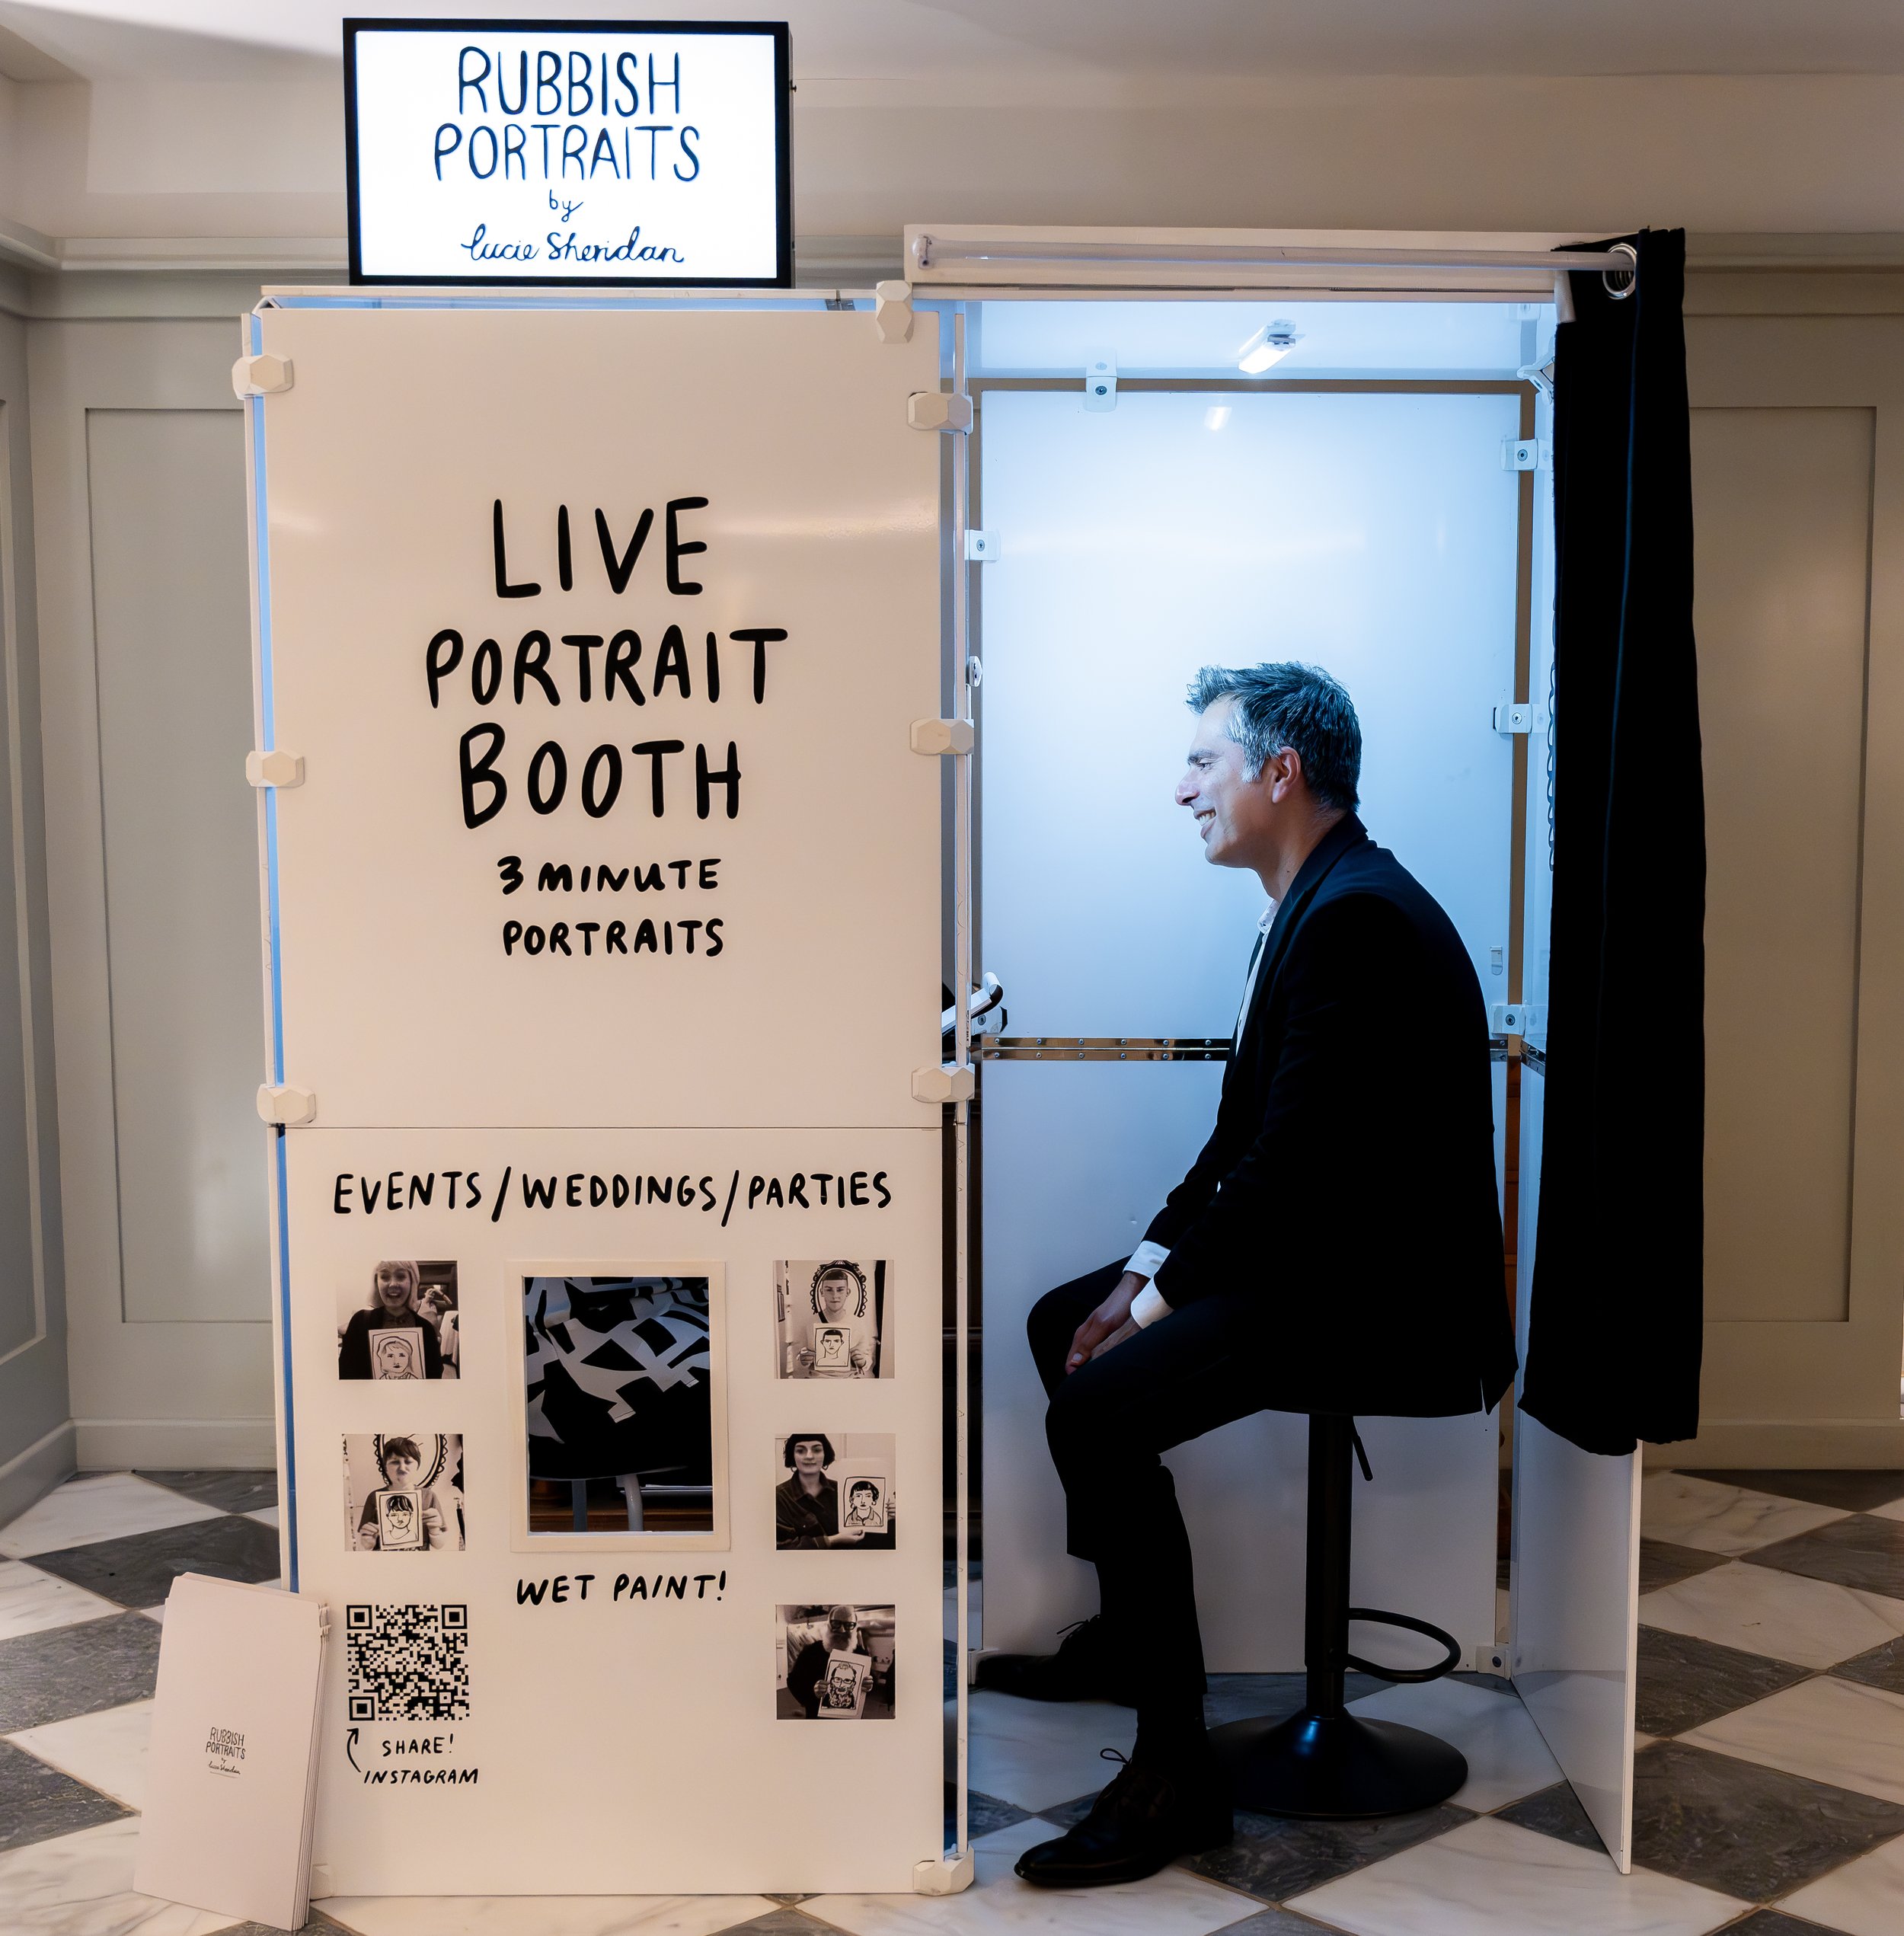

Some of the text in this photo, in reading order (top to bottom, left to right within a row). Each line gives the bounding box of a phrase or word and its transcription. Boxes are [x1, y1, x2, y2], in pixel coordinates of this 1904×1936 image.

[458, 46, 681, 117] RUBBISH
[433, 123, 701, 183] PORTRAITS
[548, 189, 584, 222] by
[546, 225, 685, 264] Sheridan
[493, 496, 709, 599] LIVE
[426, 624, 788, 709] PORTRAIT
[459, 722, 742, 830] BOOTH
[497, 855, 722, 896] 3 MINUTE
[503, 918, 724, 957] PORTRAITS
[516, 1570, 727, 1606] WET PAINT!
[205, 1741, 246, 1759] PORTRAITS
[209, 1727, 244, 1746] RUBBISH
[382, 1733, 455, 1757] SHARE!
[363, 1768, 479, 1785] INSTAGRAM
